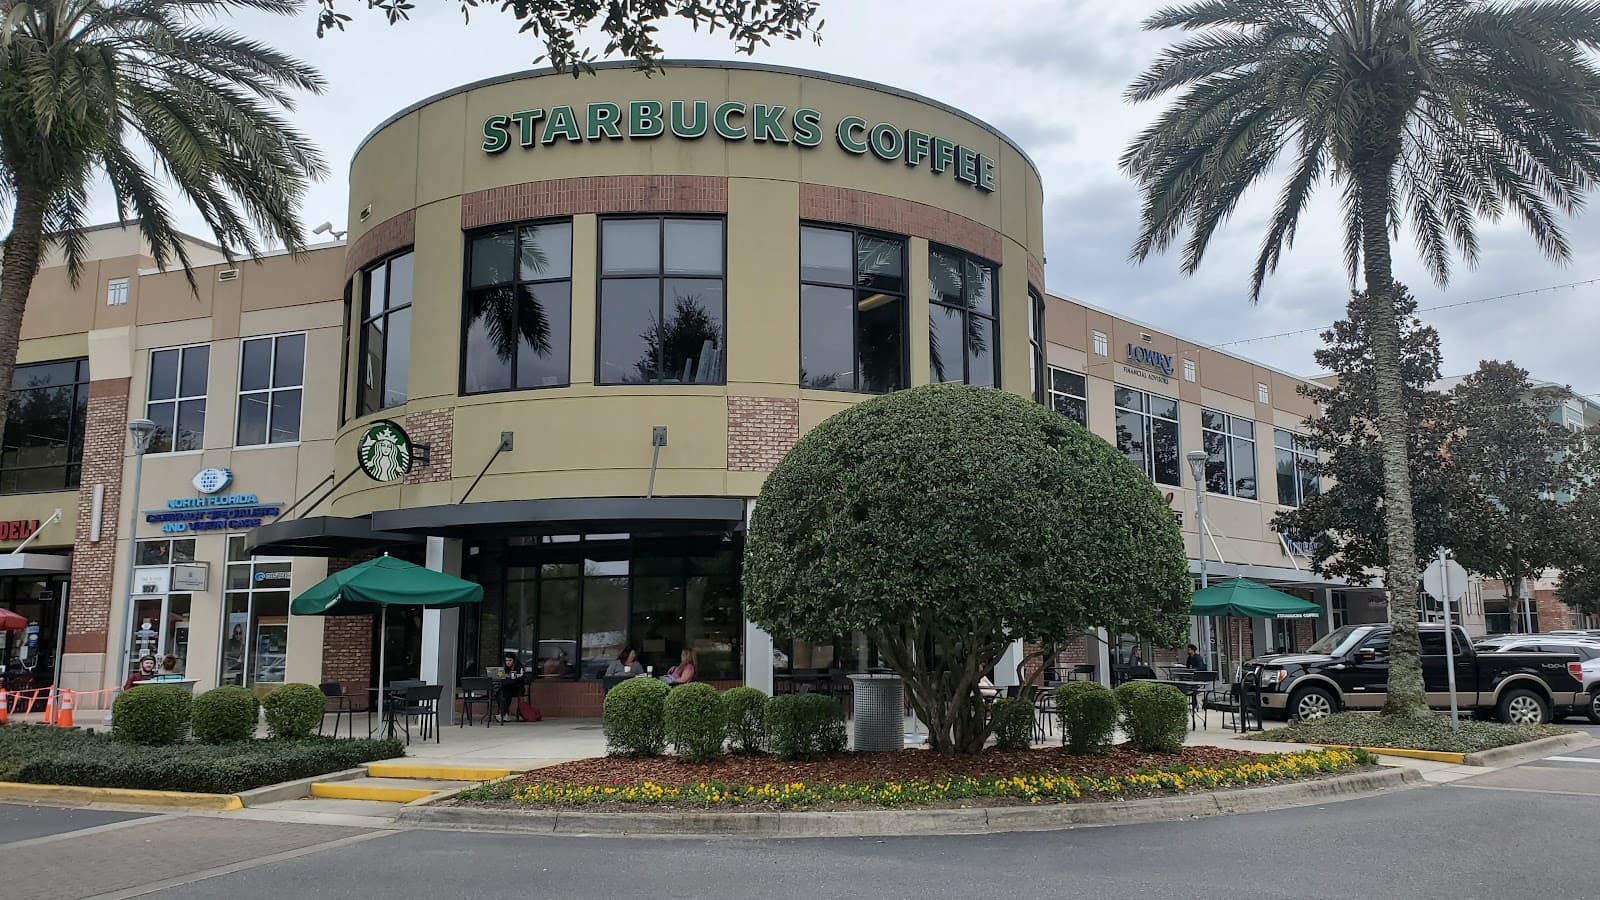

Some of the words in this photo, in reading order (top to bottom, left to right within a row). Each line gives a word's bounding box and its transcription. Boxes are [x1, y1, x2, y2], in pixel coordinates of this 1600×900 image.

[482, 100, 823, 153] STARBUCKS
[836, 115, 996, 193] COFFEE
[166, 496, 205, 509] NORTH
[207, 493, 258, 506] FLORIDA
[0, 520, 39, 540] DELI
[161, 521, 187, 533] AND
